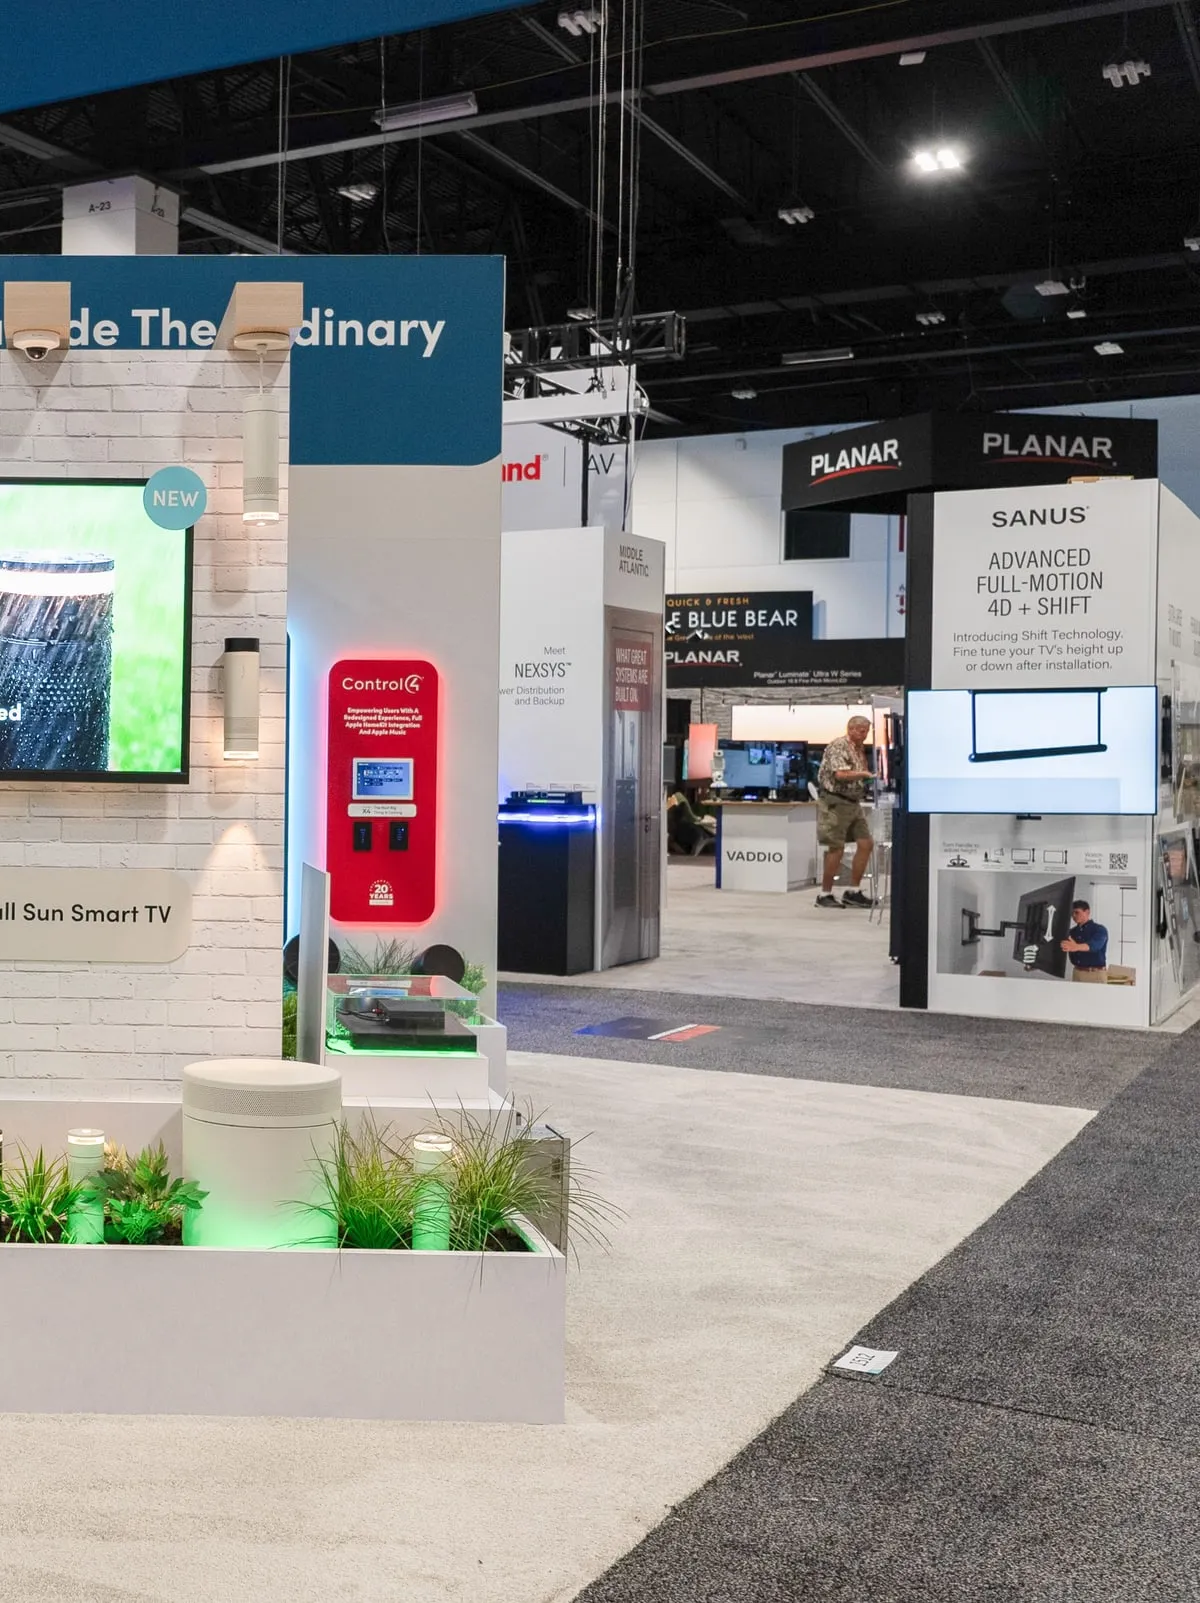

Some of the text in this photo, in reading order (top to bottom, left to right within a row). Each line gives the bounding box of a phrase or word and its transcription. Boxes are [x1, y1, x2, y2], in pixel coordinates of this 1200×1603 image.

[88, 201, 111, 213] A-23
[131, 308, 216, 346] The
[982, 432, 1114, 460] PLANAR
[811, 438, 899, 477] PLANAR
[153, 489, 199, 507] NEW
[992, 506, 1087, 528] SANUS
[619, 544, 644, 561] MIDDLE
[988, 547, 1092, 571] ADVANCED
[619, 560, 650, 577] ATLANTIC
[976, 571, 1104, 595] FULL-MOTION
[667, 598, 700, 607] QUICK
[717, 597, 749, 605] FRESH
[988, 595, 1092, 617] 4D + SHIFT
[688, 610, 738, 628] BLUE
[745, 610, 799, 627] BEAR
[953, 628, 1124, 643] Introducing Shift Technology.
[544, 647, 566, 655] Meet
[616, 648, 647, 665] WHAT GREAT
[666, 650, 740, 664] PLANAR
[953, 643, 1124, 658] Fine tune your TV's height up
[966, 658, 1113, 671] or down after installation.
[840, 670, 862, 678] Series
[516, 686, 565, 695] Distribution
[514, 697, 565, 706] and Backup
[727, 851, 783, 863] VADDIO
[374, 884, 389, 893] 20
[23, 903, 64, 922] Sun
[71, 904, 139, 923] Smart
[144, 906, 172, 924] TV
